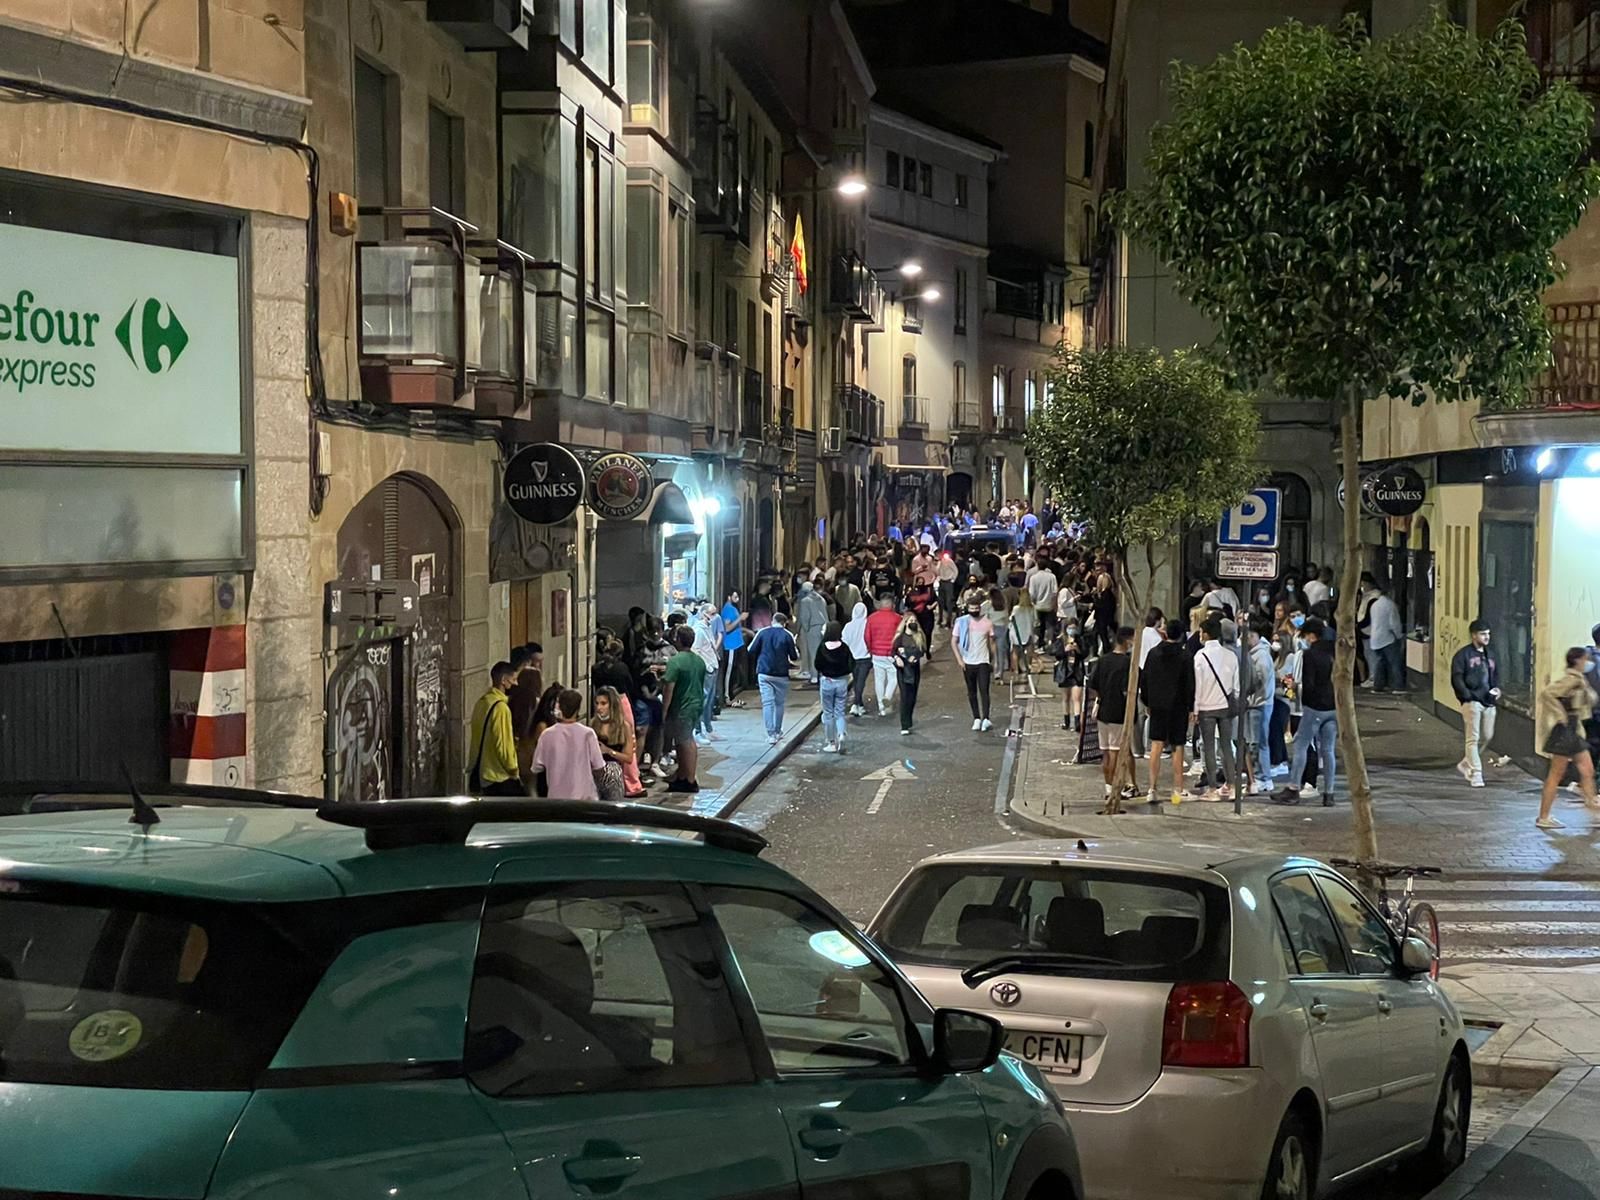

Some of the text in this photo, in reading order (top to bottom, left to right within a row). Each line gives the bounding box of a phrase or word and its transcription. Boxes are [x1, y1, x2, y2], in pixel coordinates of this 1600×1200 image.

[0, 358, 96, 393] xpress
[590, 457, 645, 484] PAULANER
[508, 482, 577, 500] GUINNESS
[1376, 489, 1422, 501] GUINNESS
[1228, 494, 1267, 540] P
[1023, 1036, 1070, 1063] CFN
